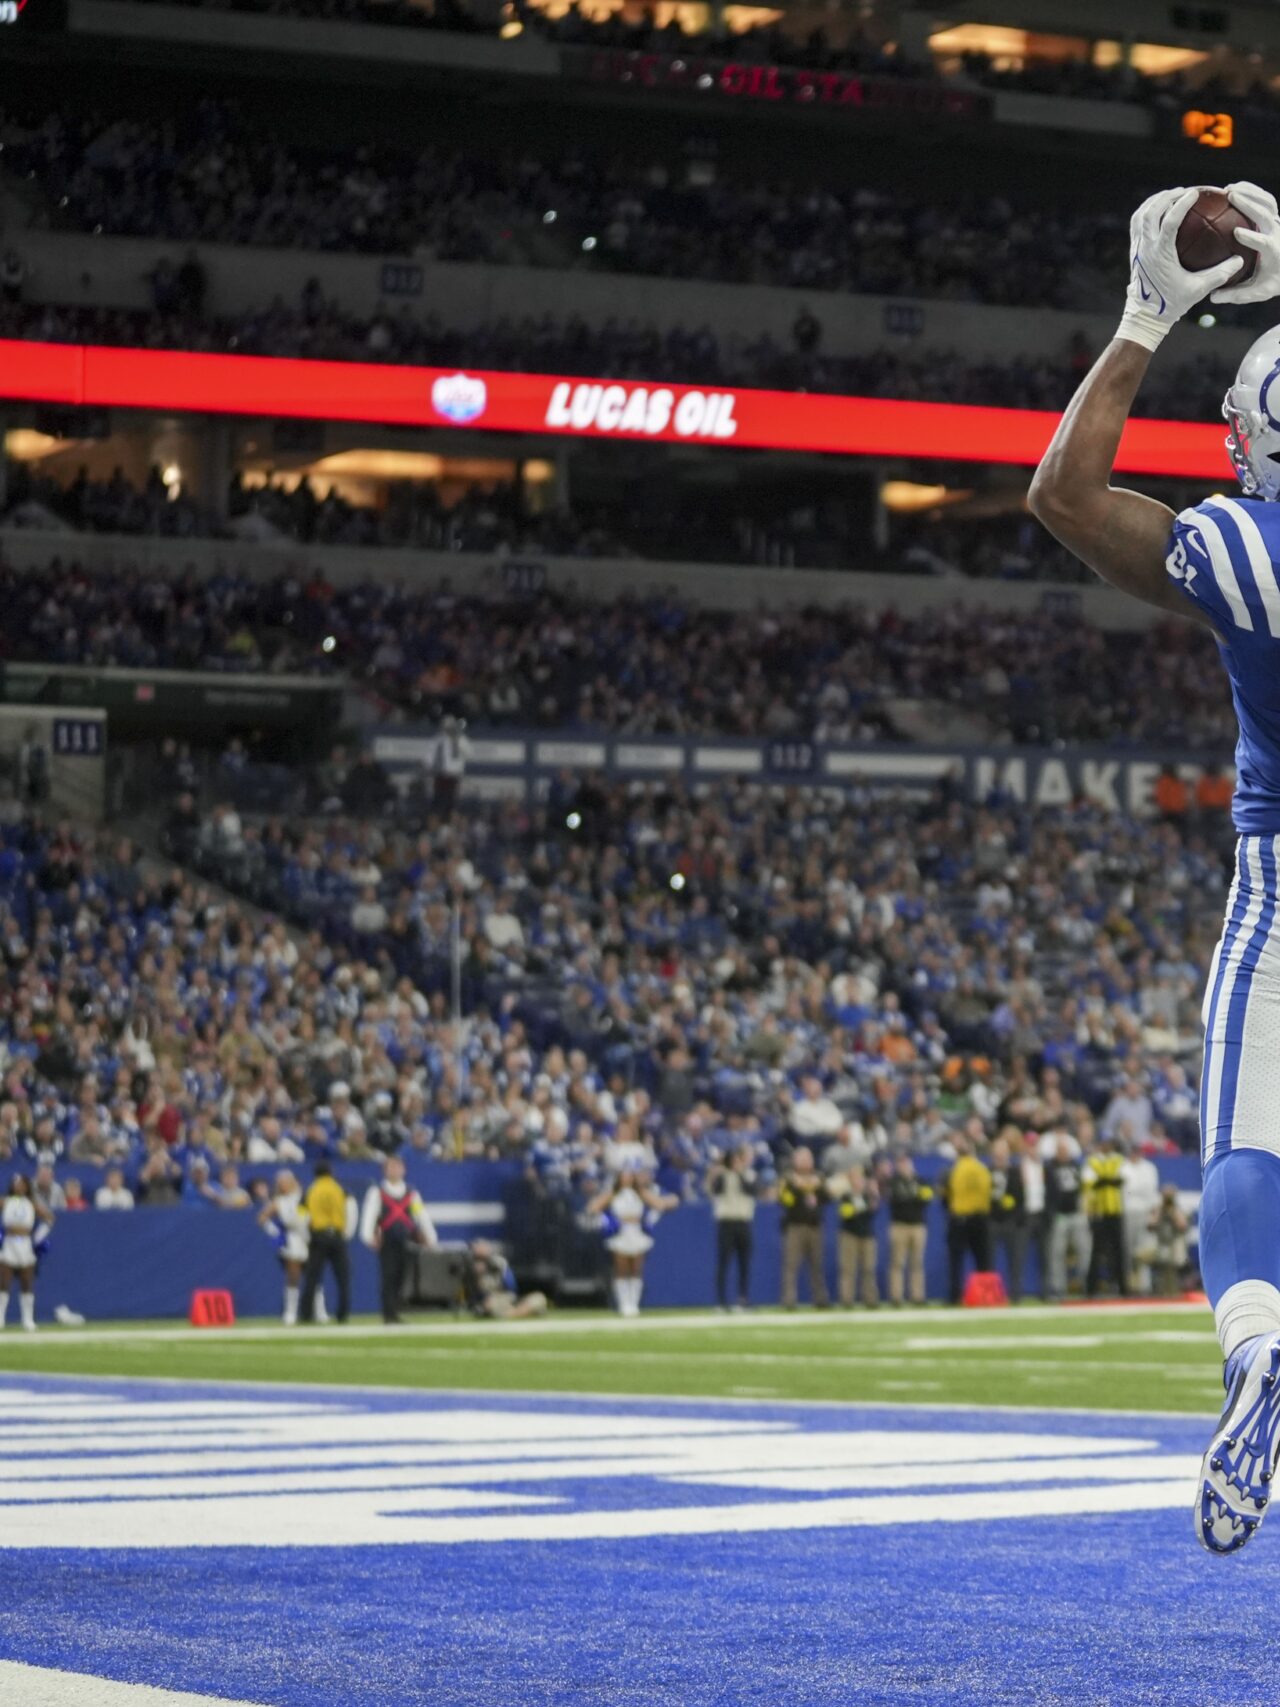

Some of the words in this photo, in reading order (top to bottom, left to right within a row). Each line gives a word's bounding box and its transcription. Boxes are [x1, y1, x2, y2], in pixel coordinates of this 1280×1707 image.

[719, 62, 785, 101] OIL
[545, 382, 675, 434] LUCAS
[674, 391, 738, 436] OIL
[58, 722, 97, 751] 111
[974, 756, 1161, 817] MAKE
[202, 1295, 229, 1323] 10
